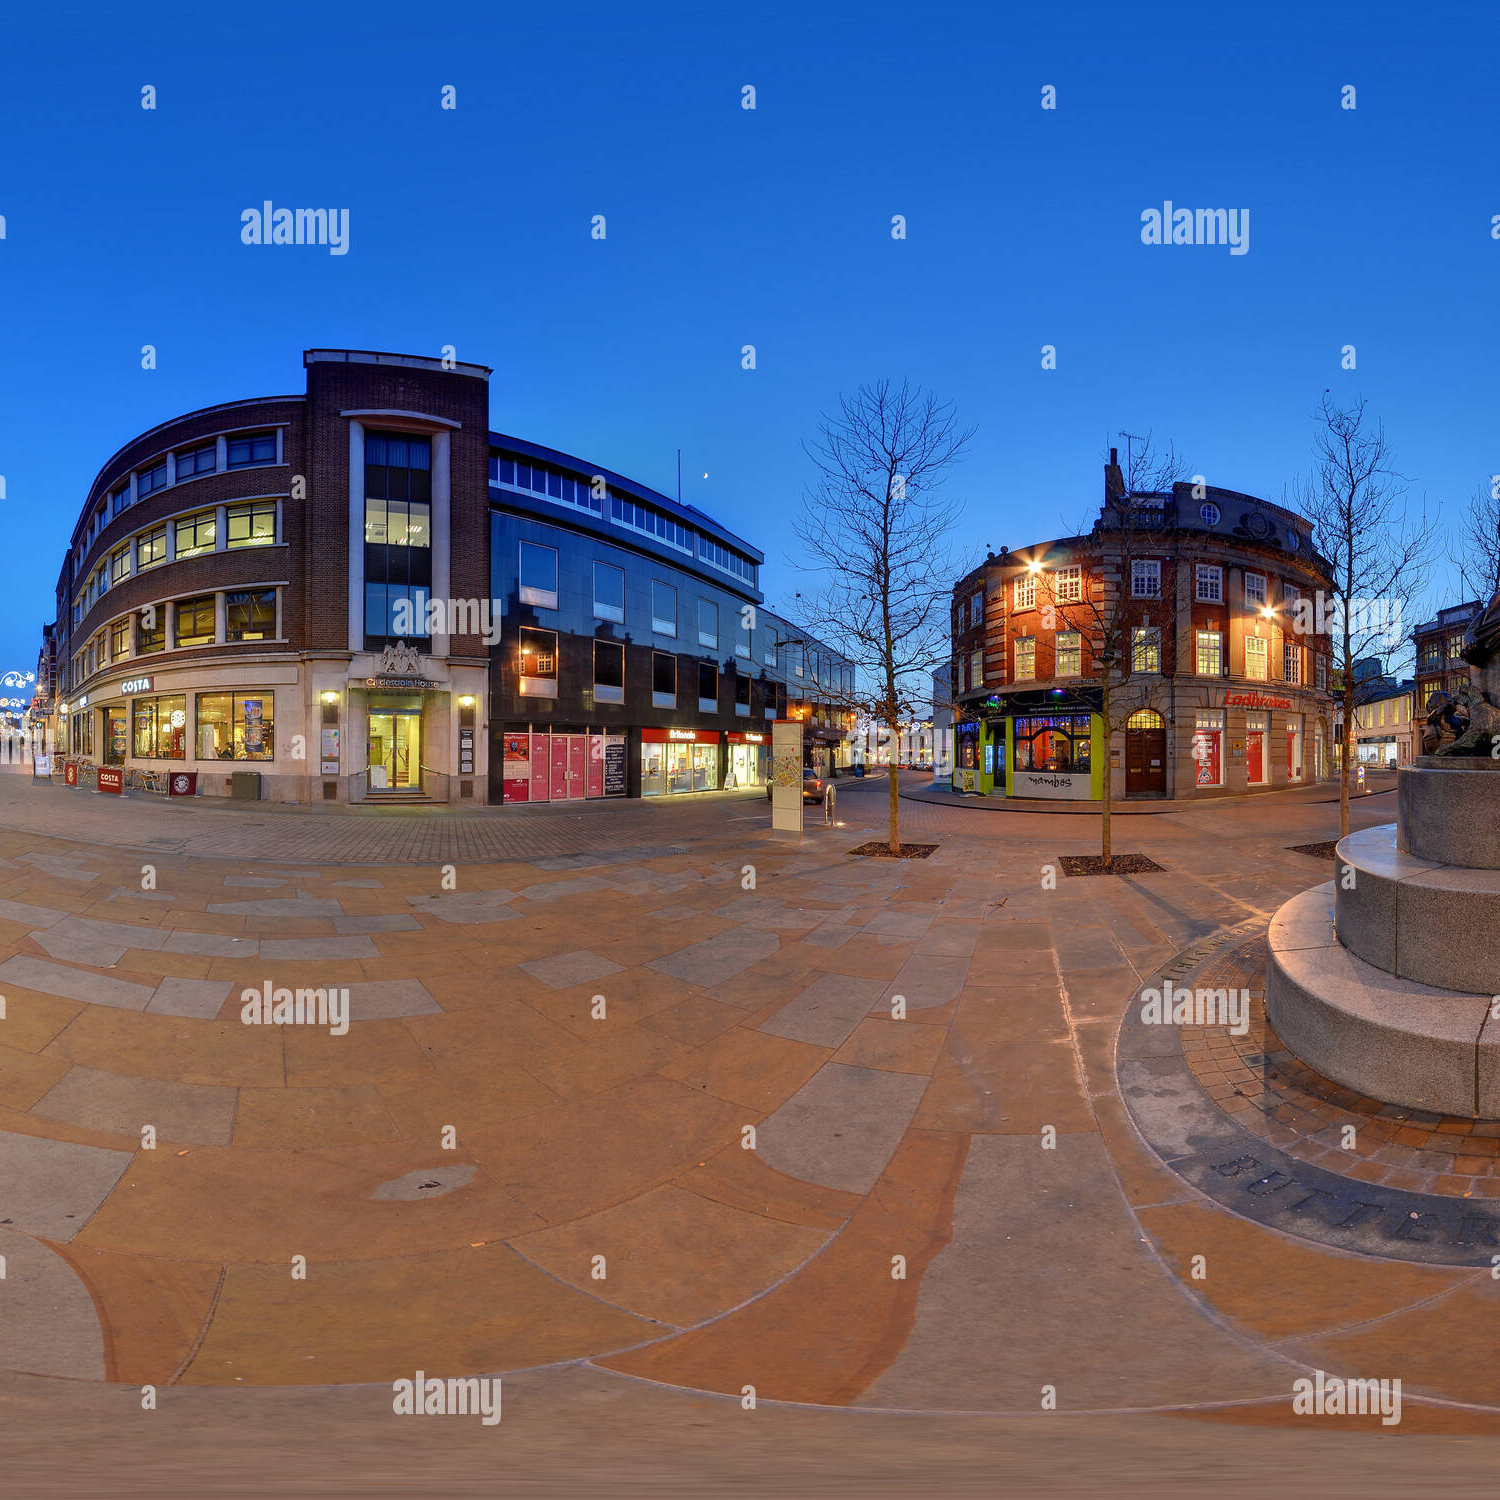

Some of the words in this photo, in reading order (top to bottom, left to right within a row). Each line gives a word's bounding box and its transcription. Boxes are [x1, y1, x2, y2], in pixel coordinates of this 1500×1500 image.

[121, 678, 150, 693] COSTA
[366, 678, 412, 688] Clydesdale
[414, 679, 439, 688] House
[1224, 690, 1292, 709] Ladbrokes
[100, 773, 119, 782] COSTA
[1028, 775, 1072, 788] mambos
[1211, 1153, 1500, 1248] BUTTER
